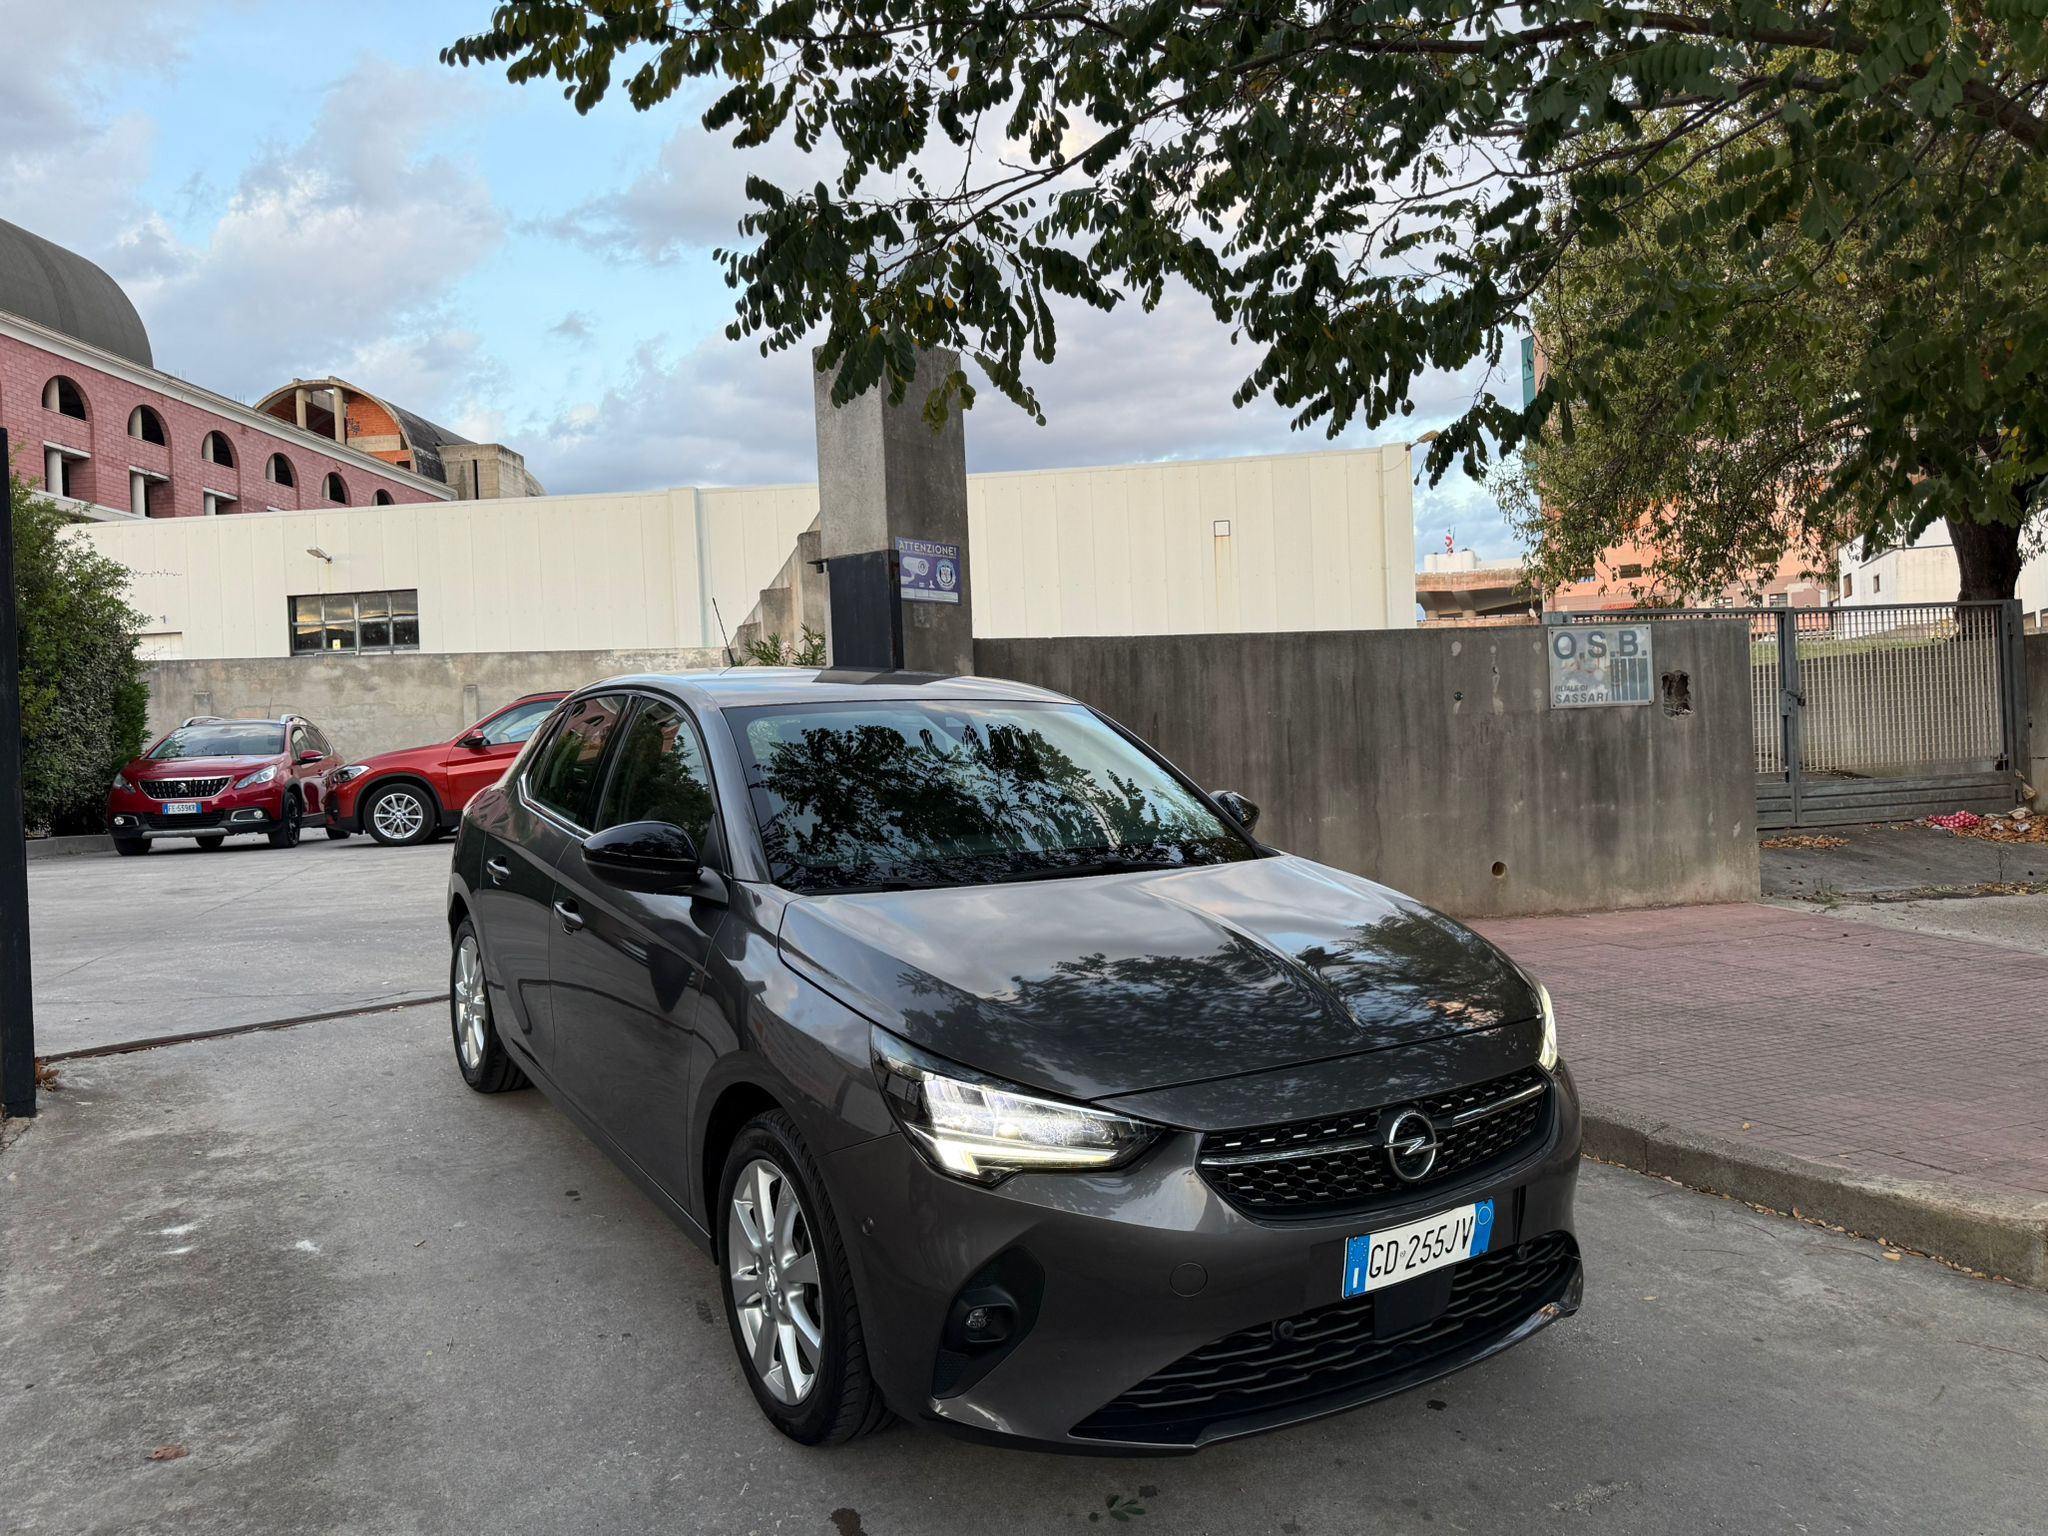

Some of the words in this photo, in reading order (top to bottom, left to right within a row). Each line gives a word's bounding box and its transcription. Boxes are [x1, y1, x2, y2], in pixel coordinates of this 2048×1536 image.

[898, 540, 957, 556] ATTENZIONE!
[1553, 630, 1648, 660] O.S.B.
[1554, 684, 1579, 692] FILIALE
[1581, 684, 1588, 692] DI
[1555, 692, 1609, 704] SASSARI
